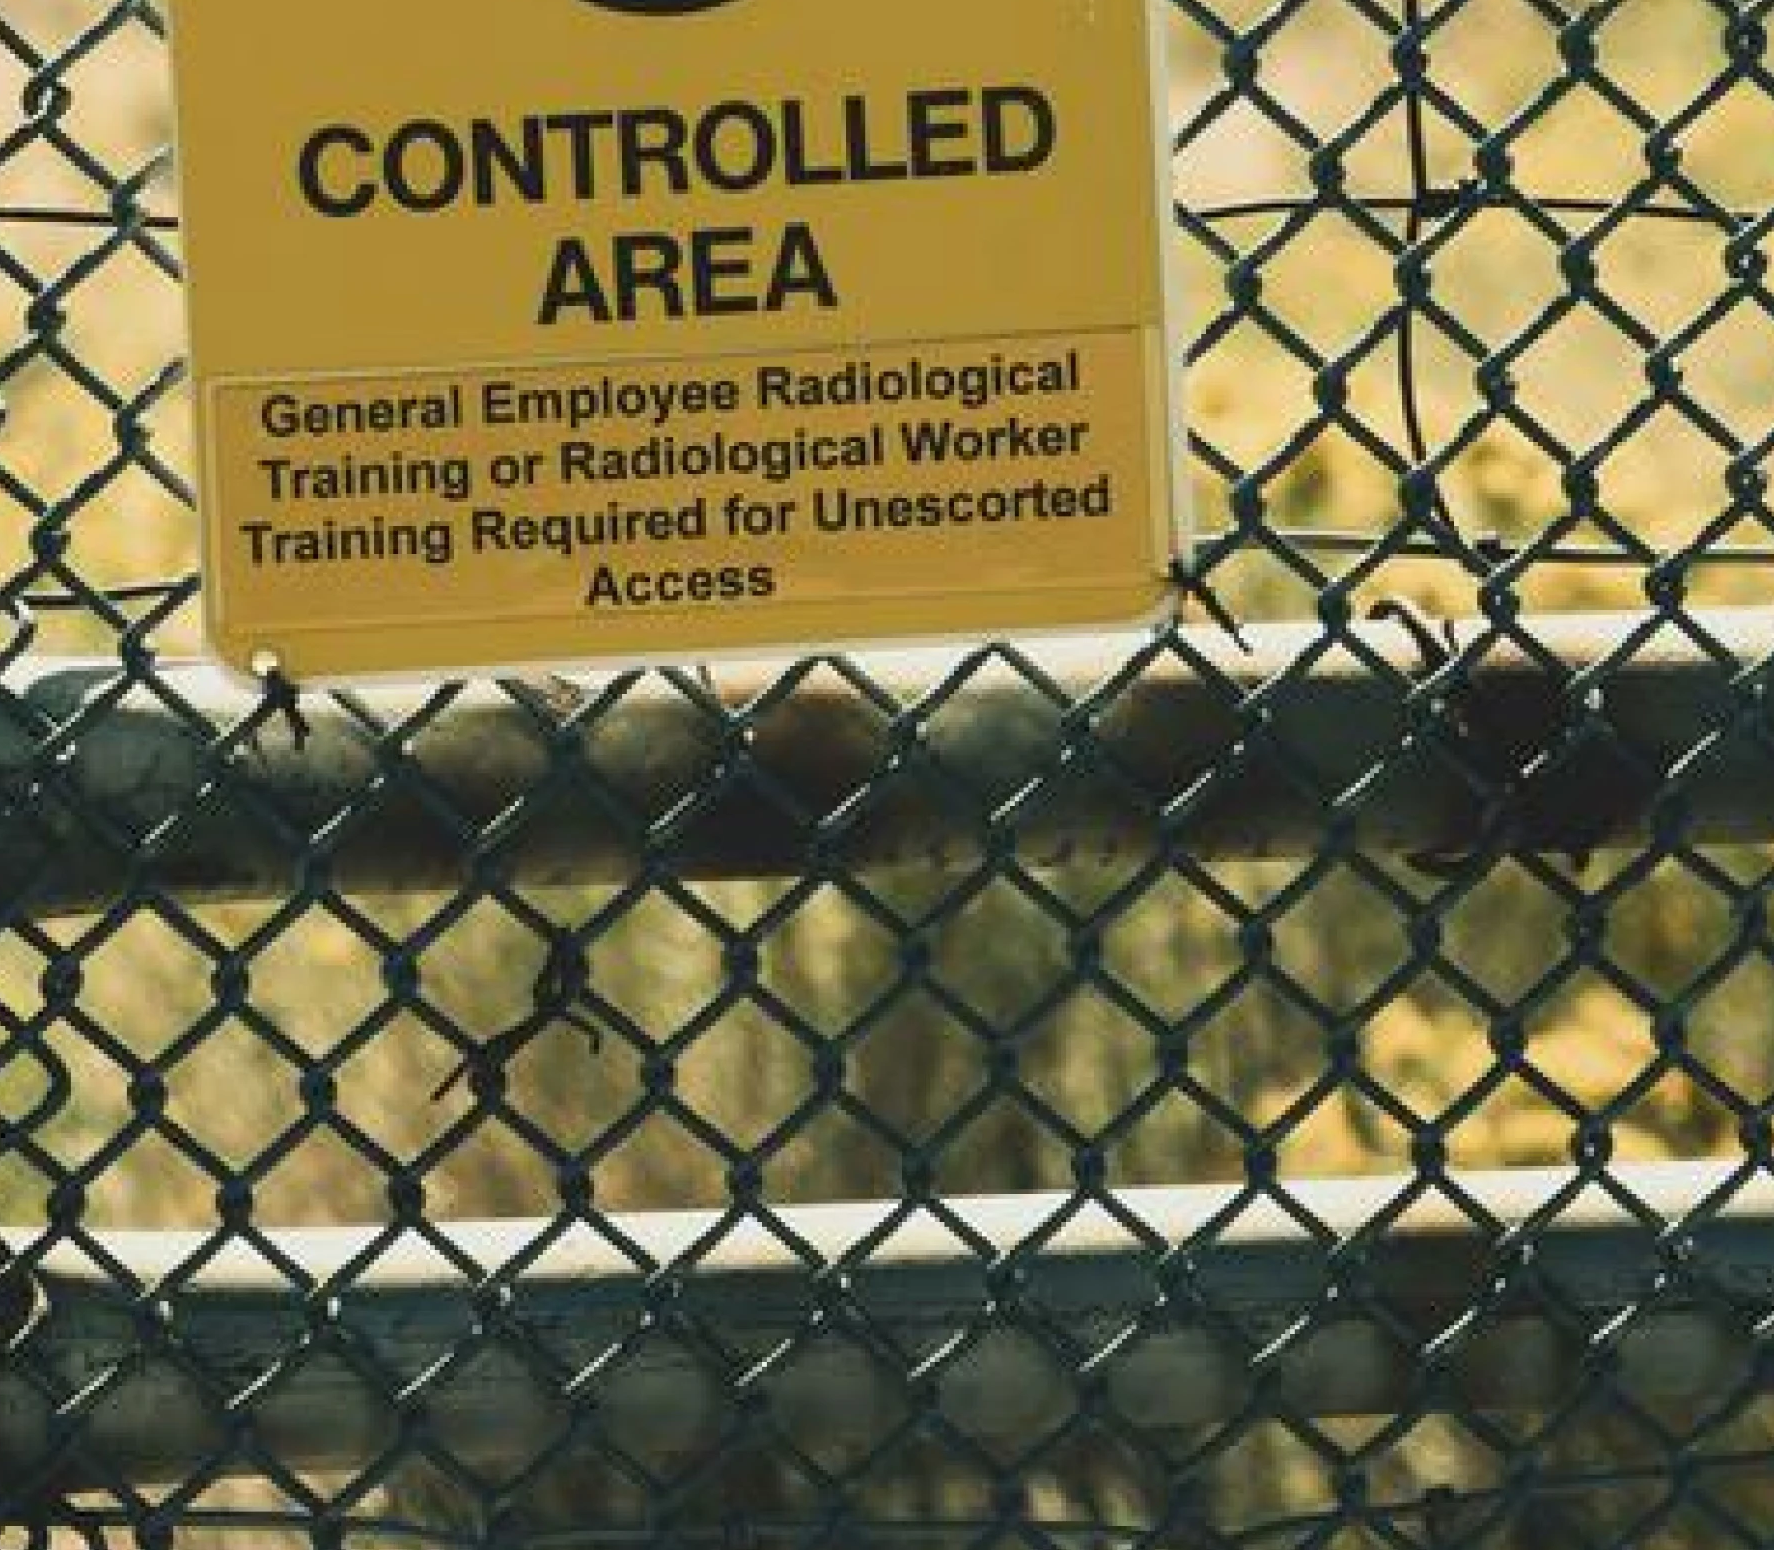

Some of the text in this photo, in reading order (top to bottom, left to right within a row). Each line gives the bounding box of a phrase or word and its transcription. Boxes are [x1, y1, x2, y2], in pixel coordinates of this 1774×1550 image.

[298, 86, 1057, 218] CONTROLLED
[537, 221, 838, 325] AREA
[261, 348, 1080, 438] General Employee Radiological
[256, 417, 1090, 503] Training or Radiological Worker
[238, 473, 1109, 564] Training Required for Unescorted
[584, 562, 777, 606] Access
